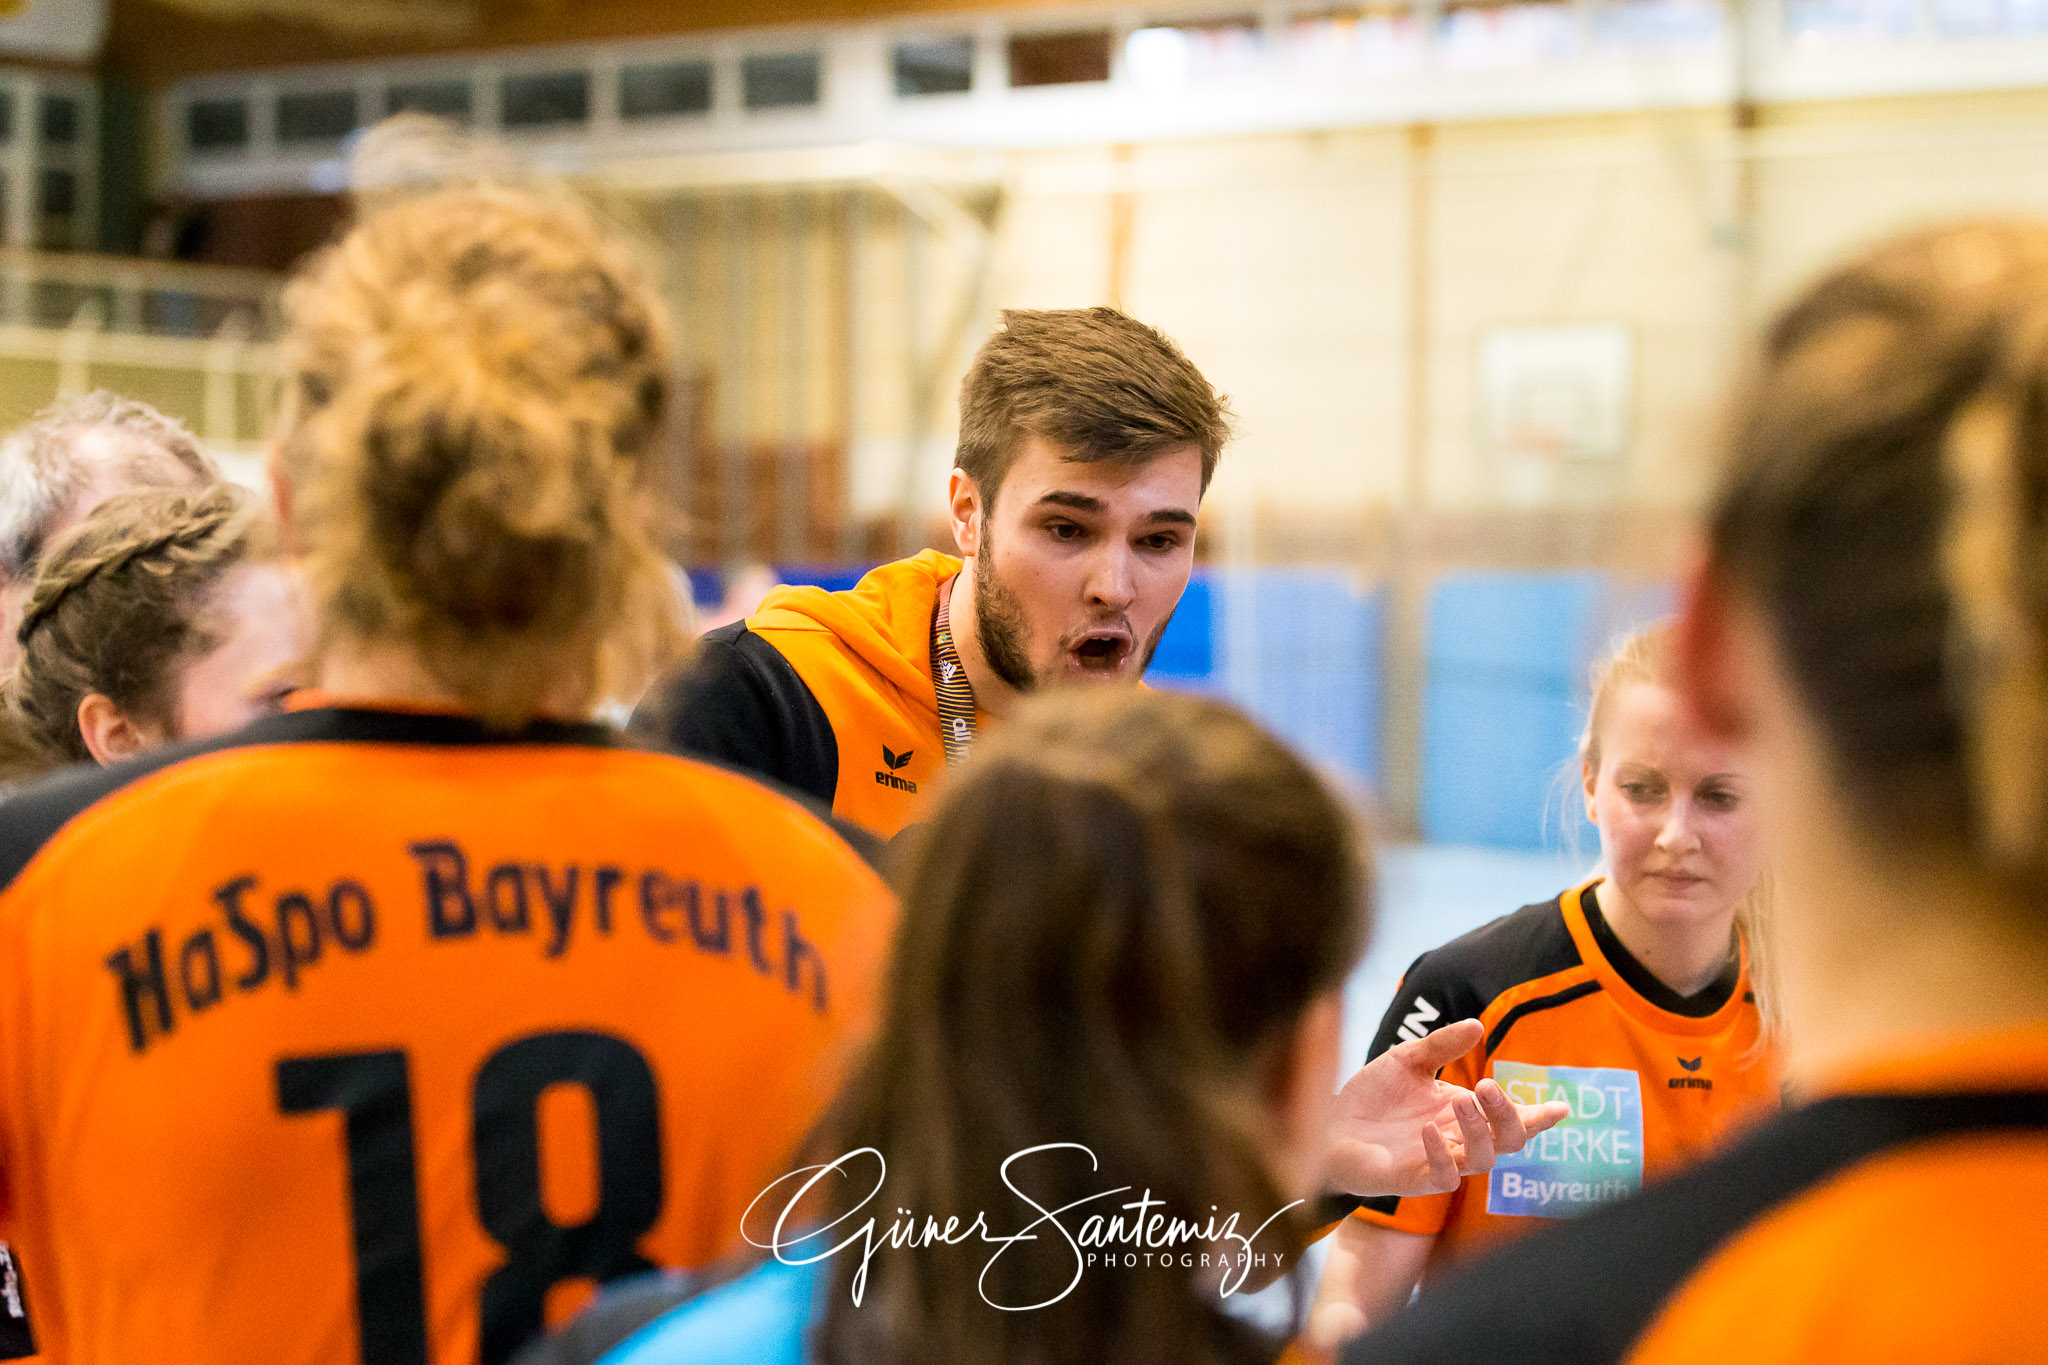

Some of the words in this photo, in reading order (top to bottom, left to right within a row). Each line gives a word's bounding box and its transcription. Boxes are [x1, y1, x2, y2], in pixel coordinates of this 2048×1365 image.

[952, 717, 972, 742] all
[874, 770, 918, 795] erima
[104, 871, 379, 1056] HaSpo
[406, 838, 831, 1015] Bayreuth
[1505, 1079, 1630, 1120] STADT
[1668, 1075, 1713, 1091] erima
[271, 1022, 670, 1365] 18
